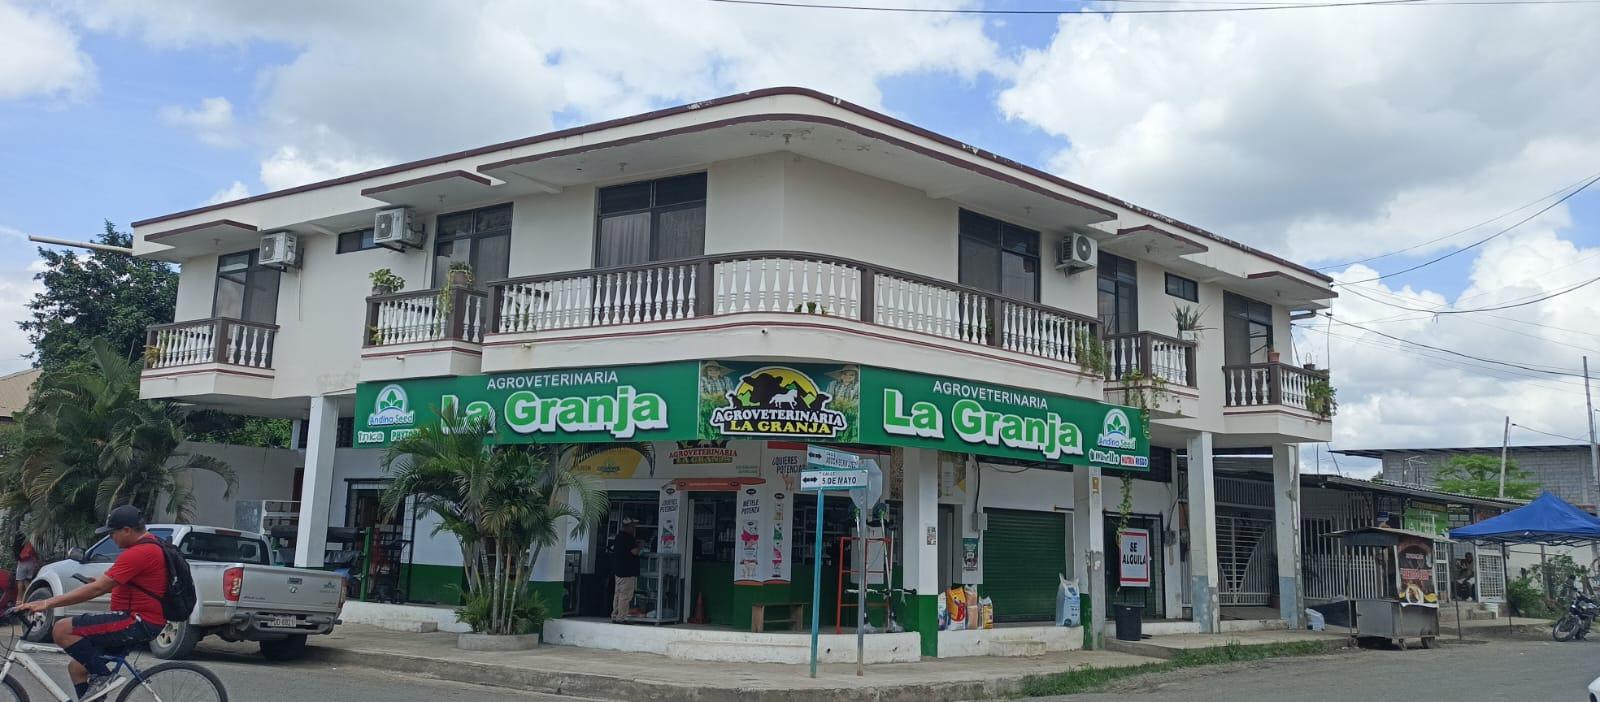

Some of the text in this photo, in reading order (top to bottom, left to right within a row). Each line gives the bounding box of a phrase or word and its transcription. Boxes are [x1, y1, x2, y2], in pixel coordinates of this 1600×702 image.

[487, 371, 618, 389] AGROVETERINARIA
[933, 380, 1048, 409] AGROVETERINARIA
[395, 411, 415, 424] Seed
[441, 386, 668, 438] La Granja
[714, 409, 843, 426] AGROVETERINARIA
[730, 420, 831, 433] LA GRANJA
[883, 388, 1083, 459] La Granja
[1120, 438, 1136, 450] Seed
[669, 449, 737, 458] AGROVETERINARIA
[1130, 542, 1138, 552] SE
[1122, 554, 1146, 565] ALQUILA
